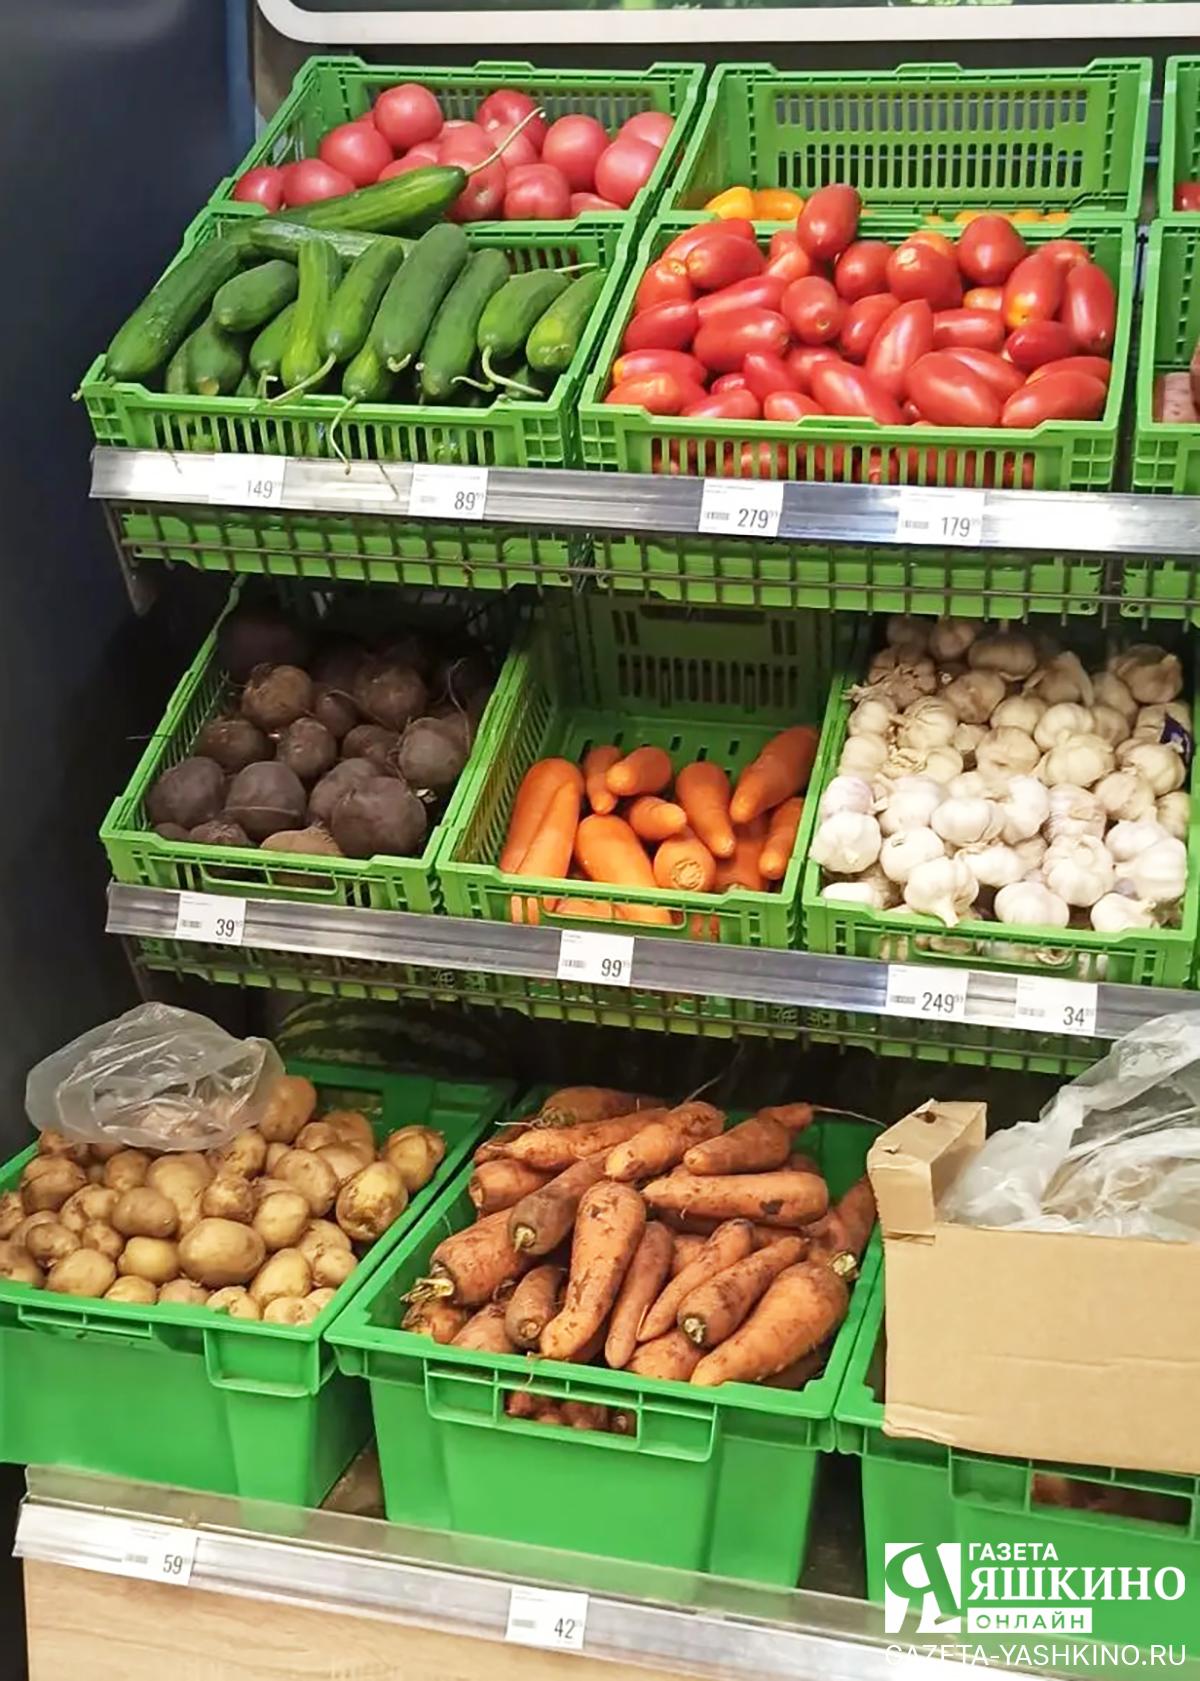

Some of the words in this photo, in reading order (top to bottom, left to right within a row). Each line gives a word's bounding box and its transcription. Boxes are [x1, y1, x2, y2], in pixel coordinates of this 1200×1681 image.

[247, 479, 273, 499] 149
[454, 491, 476, 511] 89
[737, 508, 769, 529] 279
[942, 516, 970, 537] 179
[216, 918, 235, 937] 39
[601, 958, 622, 978] 99
[921, 991, 955, 1014] 249
[1063, 1006, 1085, 1026] 34
[163, 1554, 184, 1574] 59
[554, 1618, 576, 1639] 42
